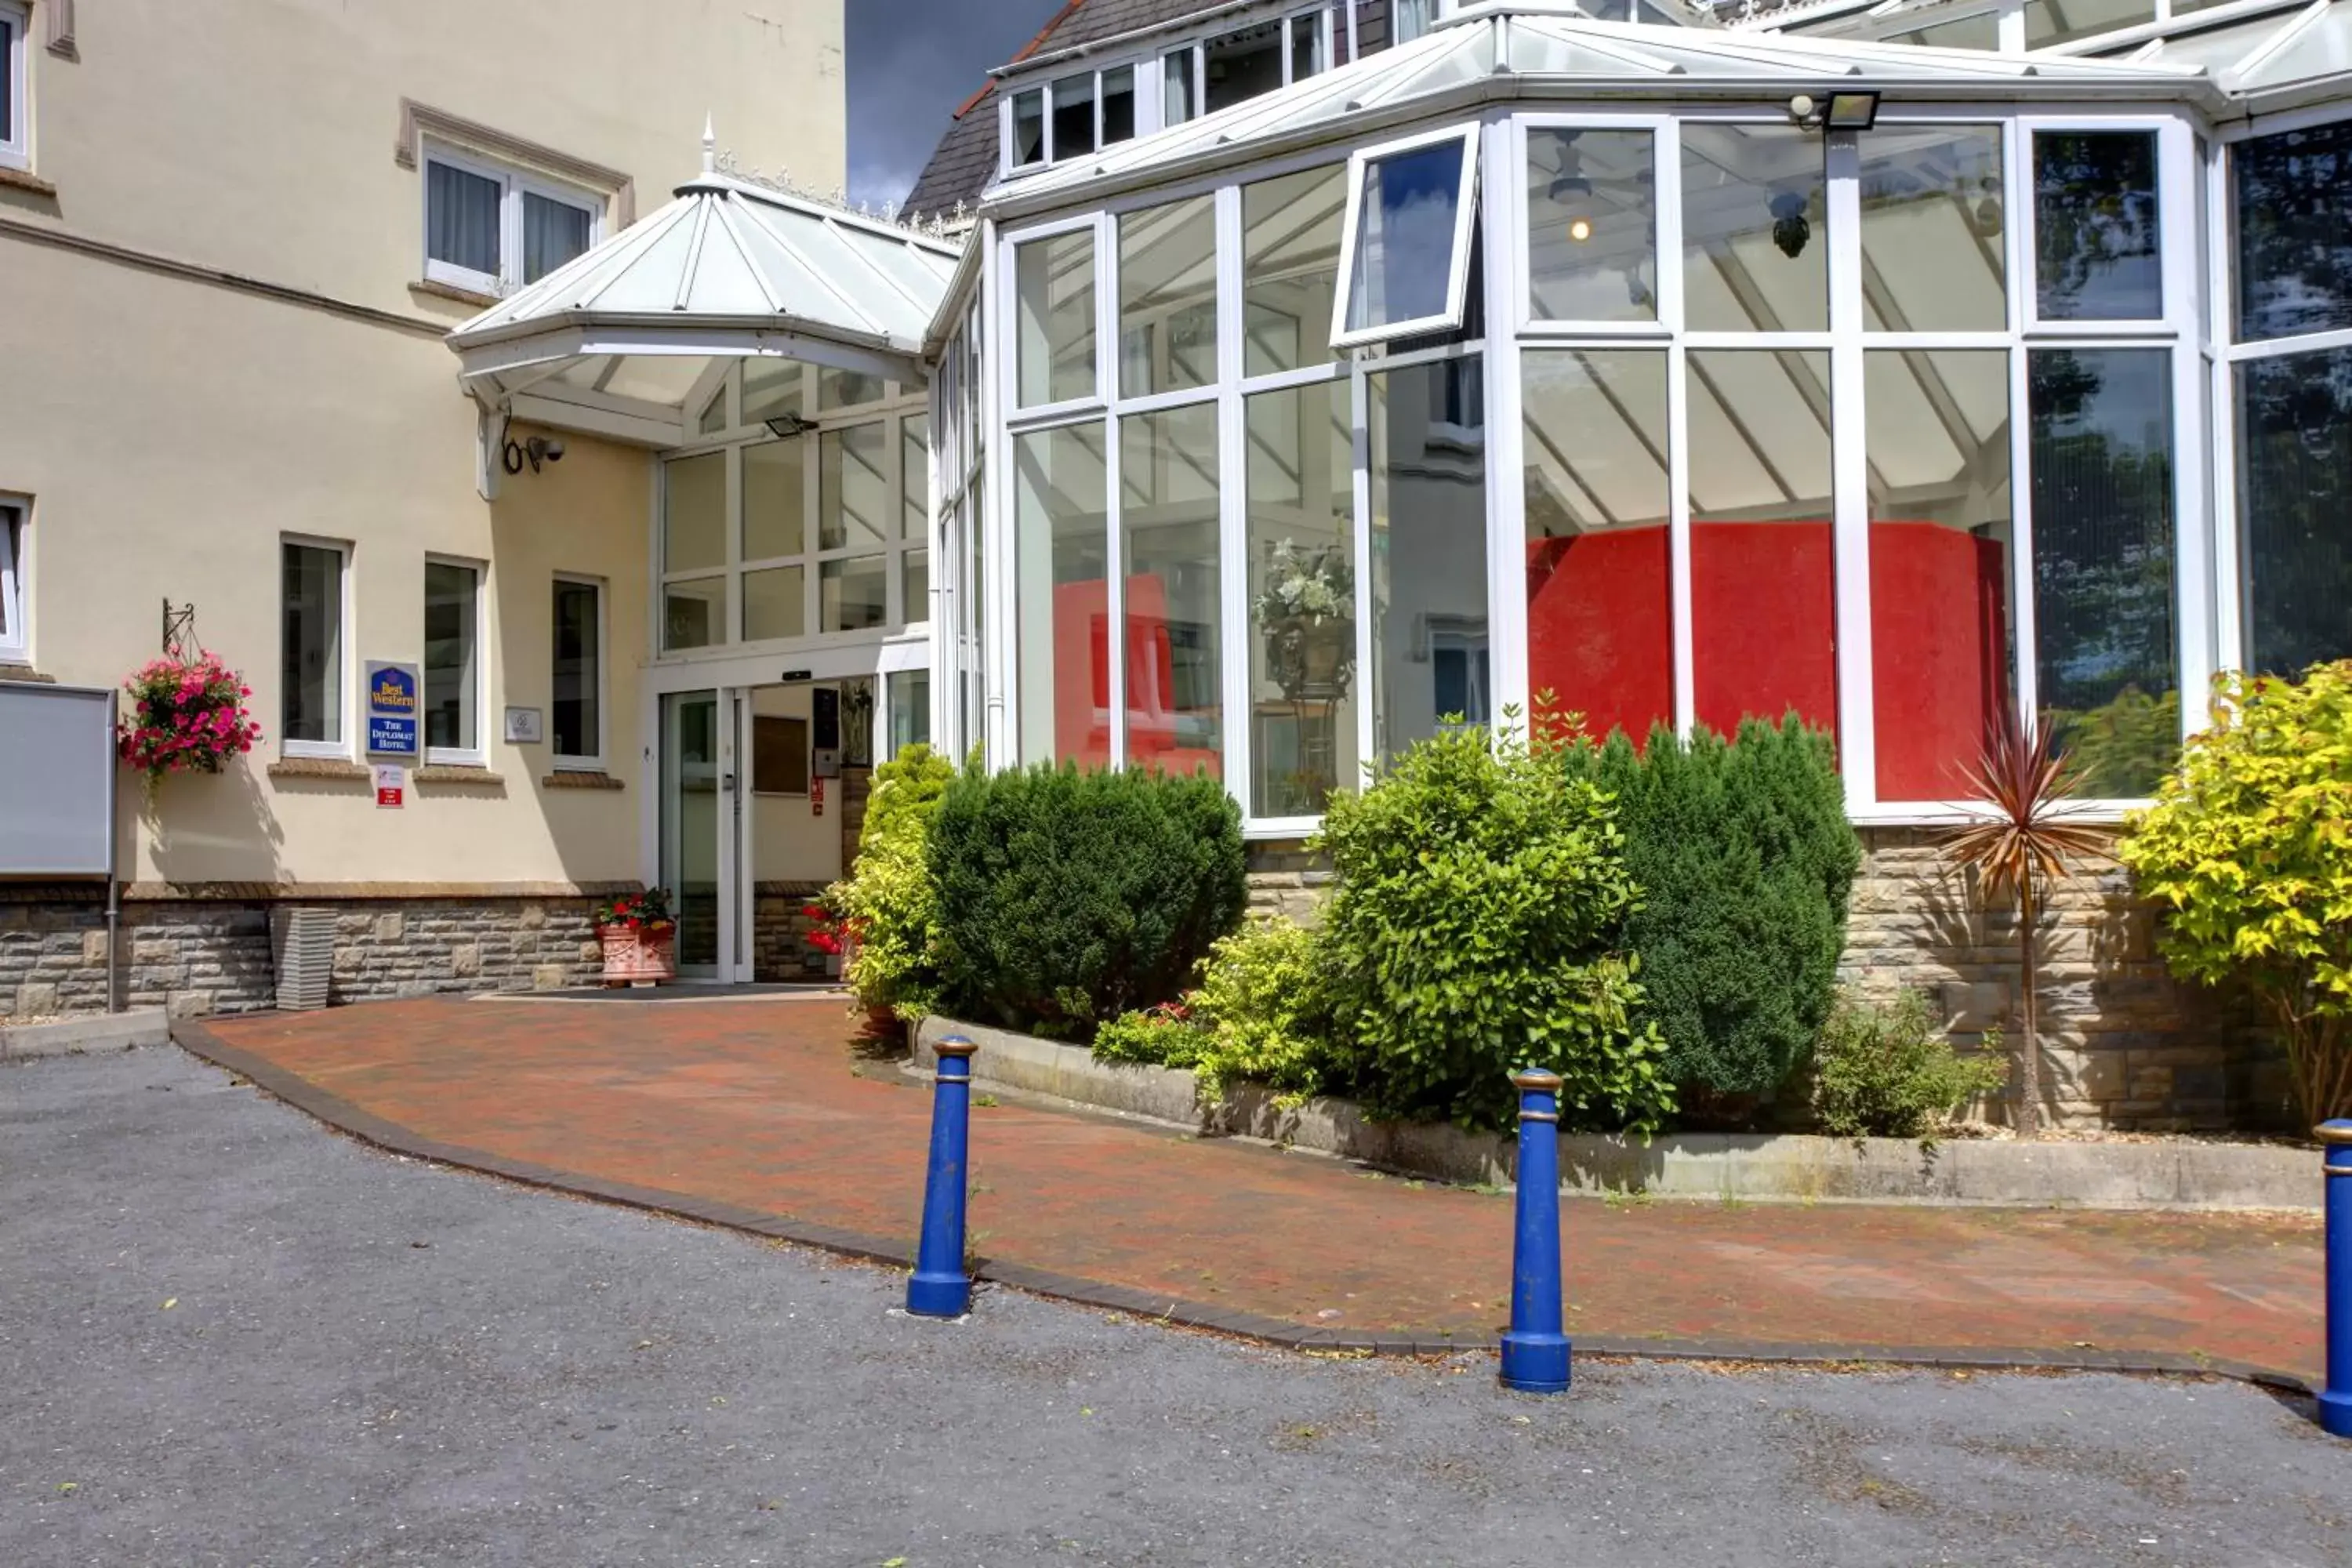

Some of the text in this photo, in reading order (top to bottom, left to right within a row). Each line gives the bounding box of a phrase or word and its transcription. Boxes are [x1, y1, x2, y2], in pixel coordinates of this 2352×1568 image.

[382, 681, 402, 695] Best
[372, 692, 414, 706] Western
[384, 720, 401, 730] THE
[372, 729, 414, 741] DIPLOMAT
[379, 739, 407, 750] HOTEL
